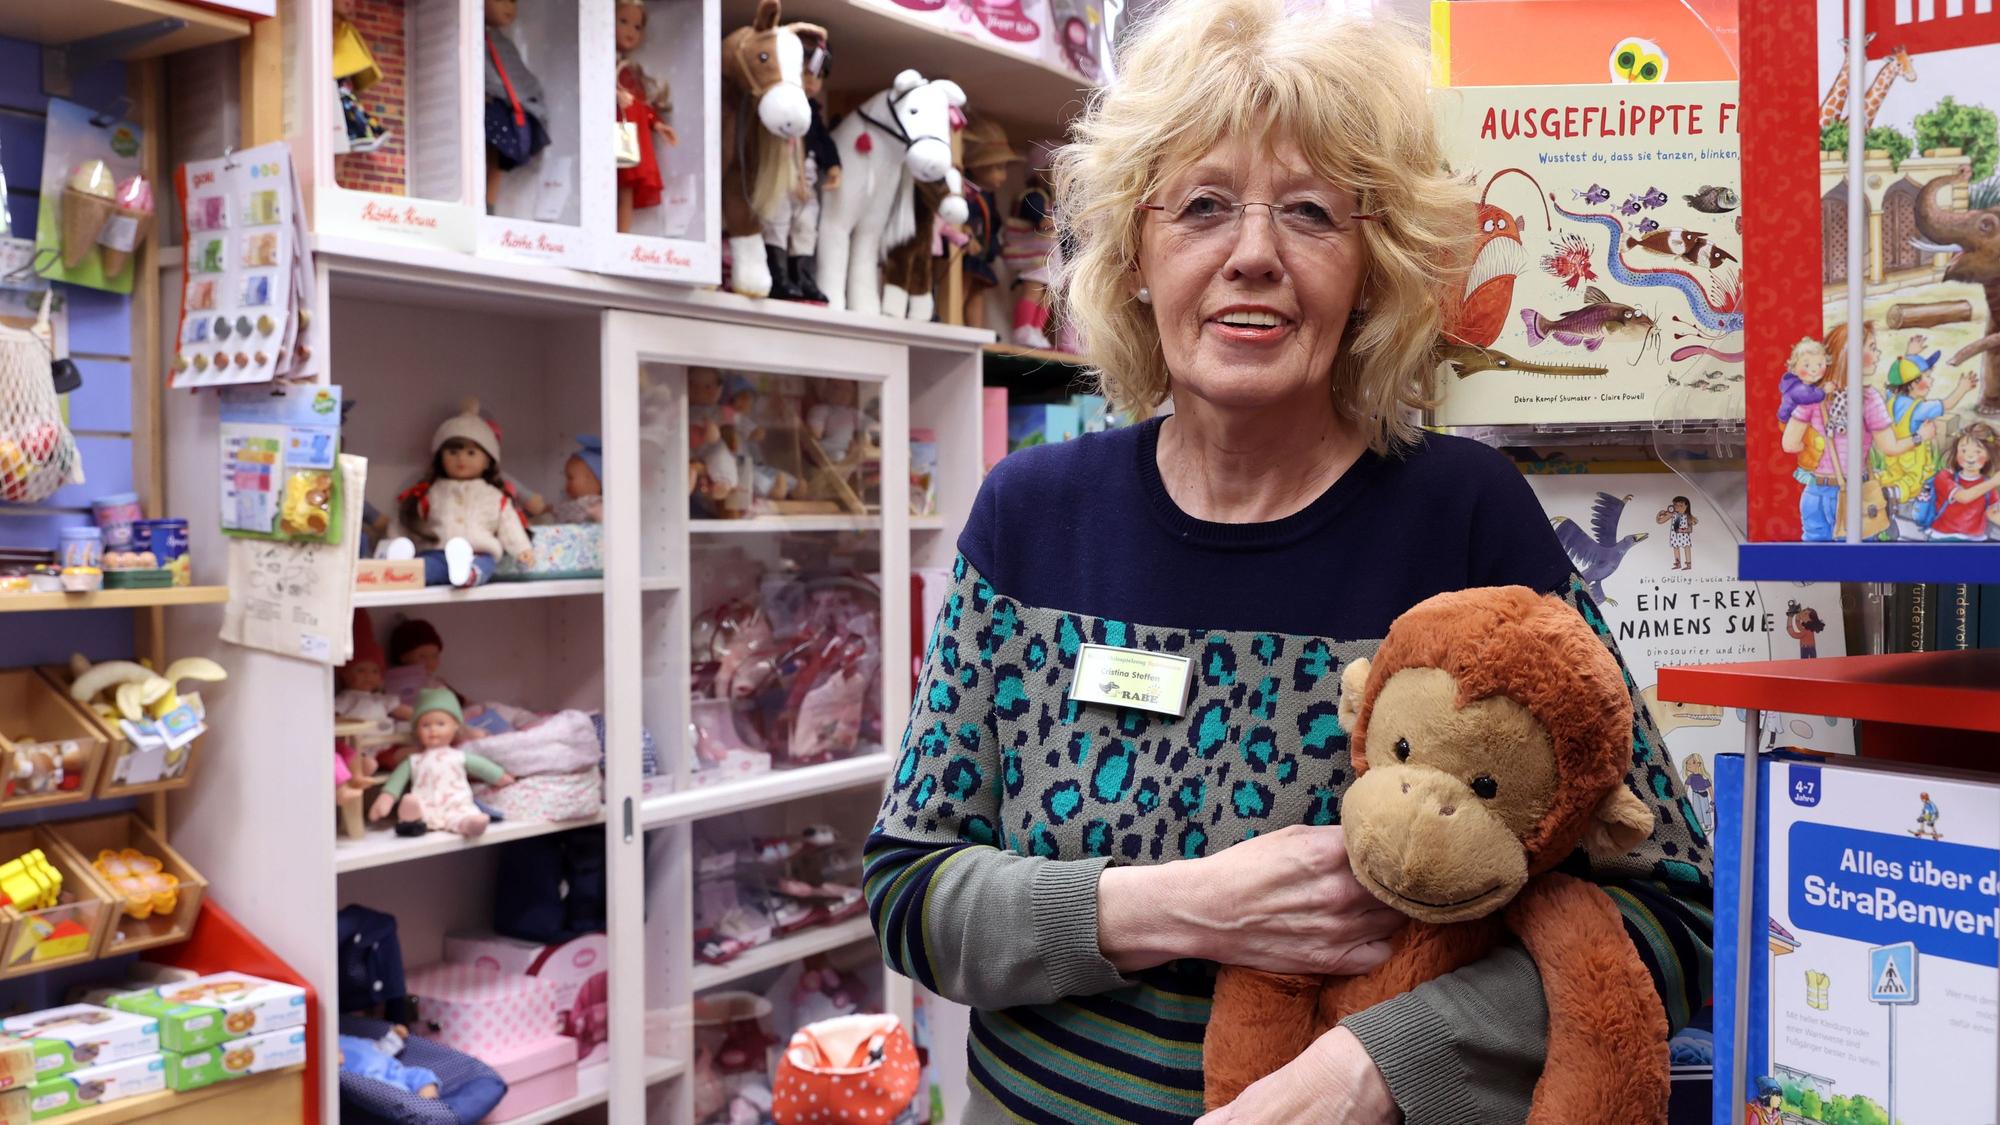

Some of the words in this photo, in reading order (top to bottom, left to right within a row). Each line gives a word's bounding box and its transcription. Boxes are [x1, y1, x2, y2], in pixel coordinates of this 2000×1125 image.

[1538, 152, 1588, 164] Wusstest
[1591, 151, 1607, 164] du,
[1610, 151, 1634, 162] dass
[1637, 150, 1652, 162] sie
[1655, 149, 1697, 163] tanzen,
[1700, 148, 1740, 161] blinken,
[1513, 395, 1534, 404] Debra
[1535, 394, 1558, 404] Kempf
[1559, 394, 1591, 403] Shumaker
[1600, 392, 1620, 402] Claire
[1622, 392, 1645, 401] Powell
[1700, 576, 1723, 584] Lucia
[1690, 589, 1756, 610] T-REX
[1619, 616, 1711, 641] NAMENS
[1725, 612, 1775, 635] SUE
[1647, 645, 1709, 657] Dinosaurier
[1715, 645, 1733, 655] und
[1738, 643, 1756, 655] ihre
[1131, 671, 1161, 683] Steffen
[1121, 690, 1159, 704] RABE
[1794, 780, 1815, 795] 4-7
[1793, 793, 1816, 803] Jahre
[1839, 847, 1904, 881] Alles
[1908, 859, 1973, 892] über
